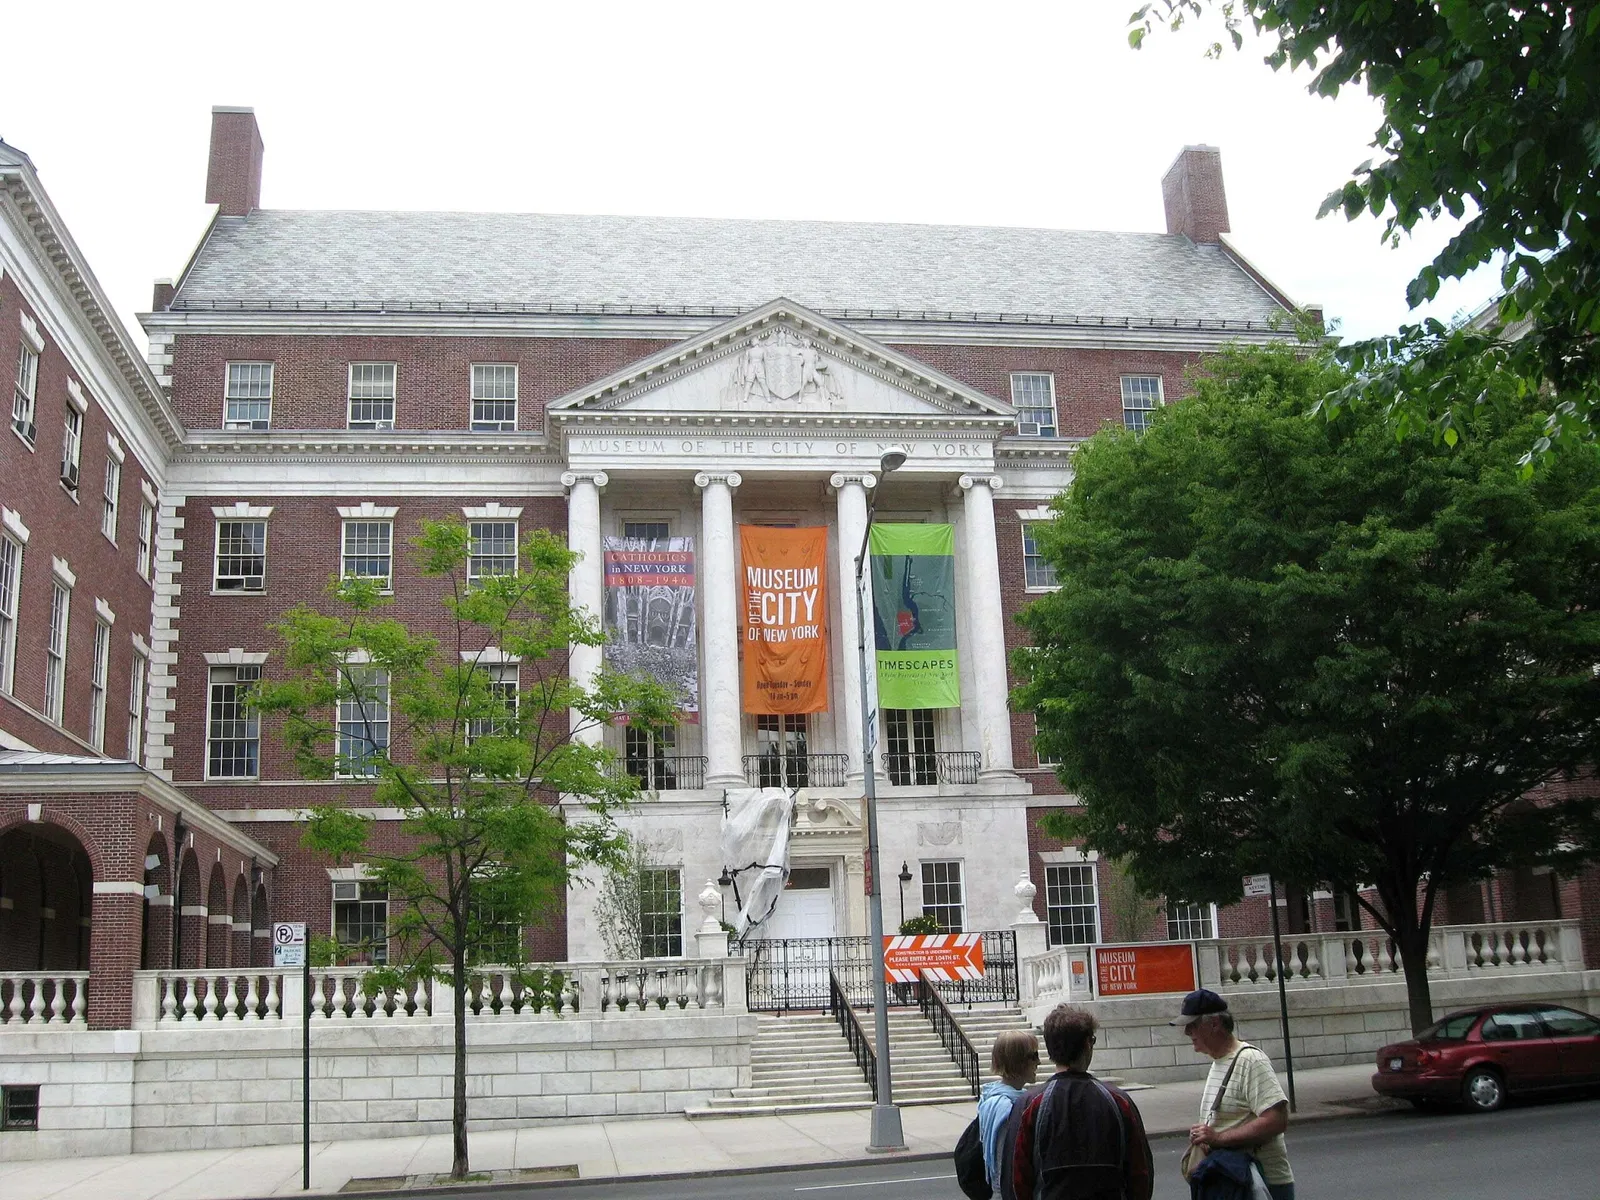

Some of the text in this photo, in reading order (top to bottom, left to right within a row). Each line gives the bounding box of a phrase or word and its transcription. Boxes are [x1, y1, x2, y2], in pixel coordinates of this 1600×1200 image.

[580, 440, 665, 453] MUSEUM
[681, 440, 704, 453] OF
[721, 441, 755, 454] THE
[771, 441, 814, 454] CITY
[835, 442, 857, 455] OF
[933, 443, 981, 456] YORK
[611, 553, 687, 562] CATHOLICS
[611, 564, 686, 573] in NEW YORK
[747, 566, 818, 590] MUSEUM
[748, 590, 761, 624] OF THE
[762, 588, 818, 625] CITY
[748, 624, 819, 642] OF NEW YORK
[878, 659, 954, 670] TIMESCAPES
[1099, 951, 1136, 964] MUSEUM
[1110, 964, 1136, 982] CITY
[1101, 982, 1138, 991] OF NEW YORK
